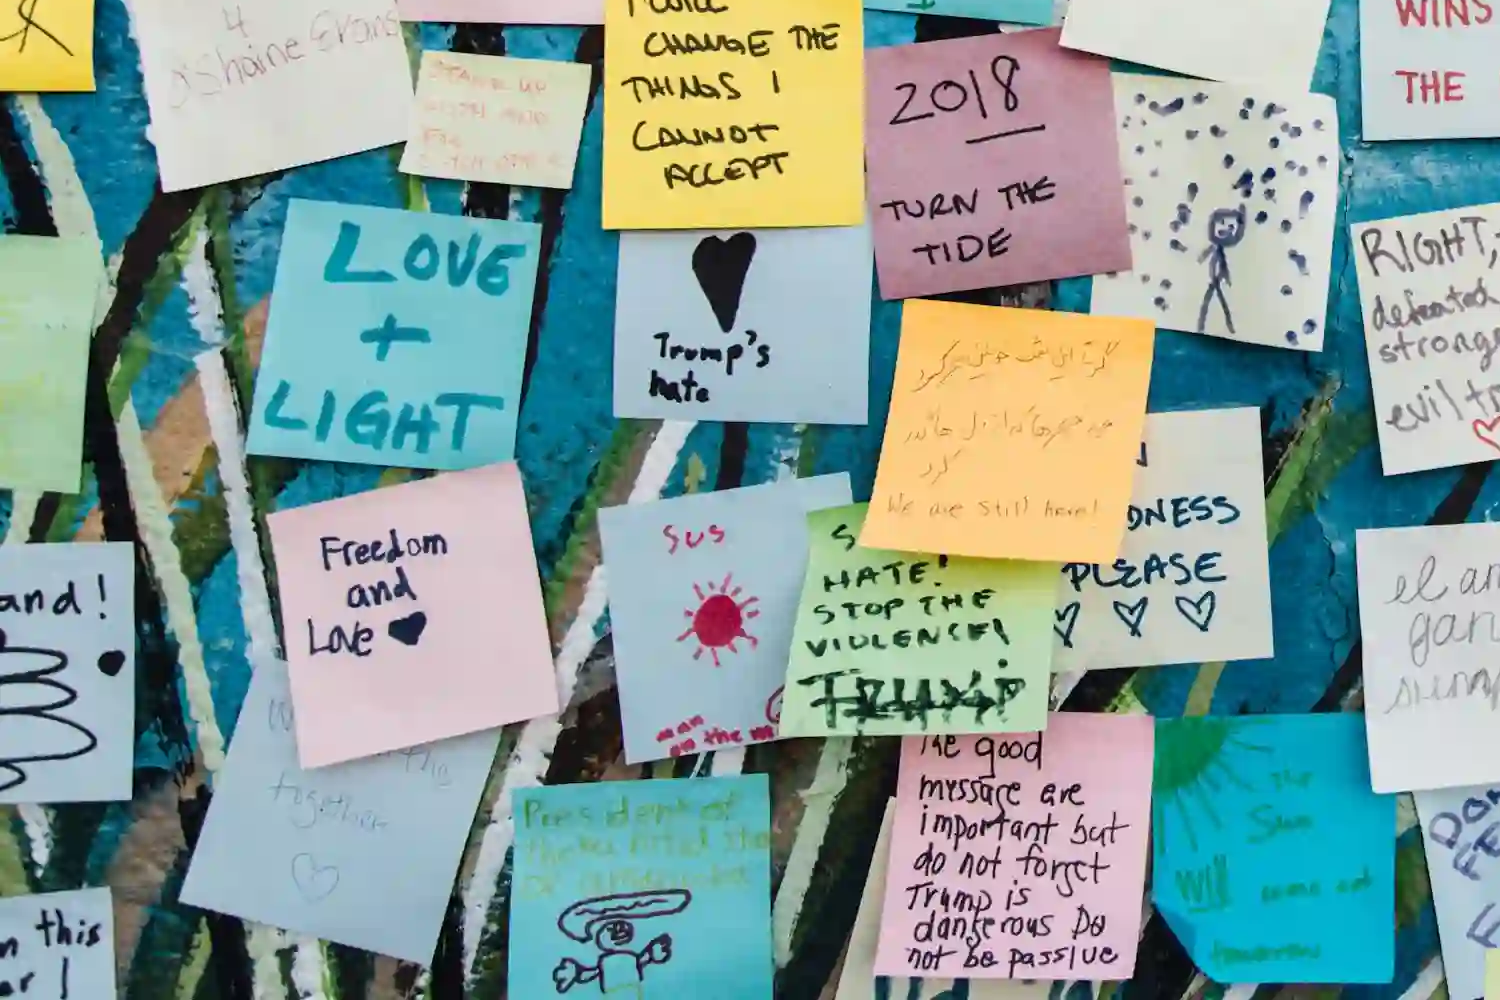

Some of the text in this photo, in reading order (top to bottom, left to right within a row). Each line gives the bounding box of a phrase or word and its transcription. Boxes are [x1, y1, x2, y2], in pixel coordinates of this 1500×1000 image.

[645, 23, 841, 56] CHANGE THE
[621, 71, 779, 103] THINGS I
[890, 55, 1021, 125] 2018
[1394, 70, 1466, 104] THE
[633, 121, 779, 152] CANNOT
[664, 152, 788, 189] ACCEPT
[880, 174, 1056, 222] TURN THE
[324, 221, 527, 295] LOVE
[912, 229, 1013, 266] TIDE
[648, 370, 710, 404] hate
[264, 380, 504, 453] LIGHT
[319, 530, 449, 570] Freedom
[347, 570, 417, 608] and
[823, 555, 950, 592] HATE!
[1061, 550, 1227, 593] PLEASE
[814, 589, 997, 624] STOP THE
[308, 619, 374, 656] Love
[976, 736, 1042, 779] good
[1040, 784, 1085, 807] are
[919, 807, 1129, 855] important but
[912, 843, 1111, 898] do not forget
[906, 880, 1030, 927] Trump is
[36, 909, 102, 947] this
[914, 913, 1050, 951] dangerous
[905, 942, 1118, 978] not be passive
